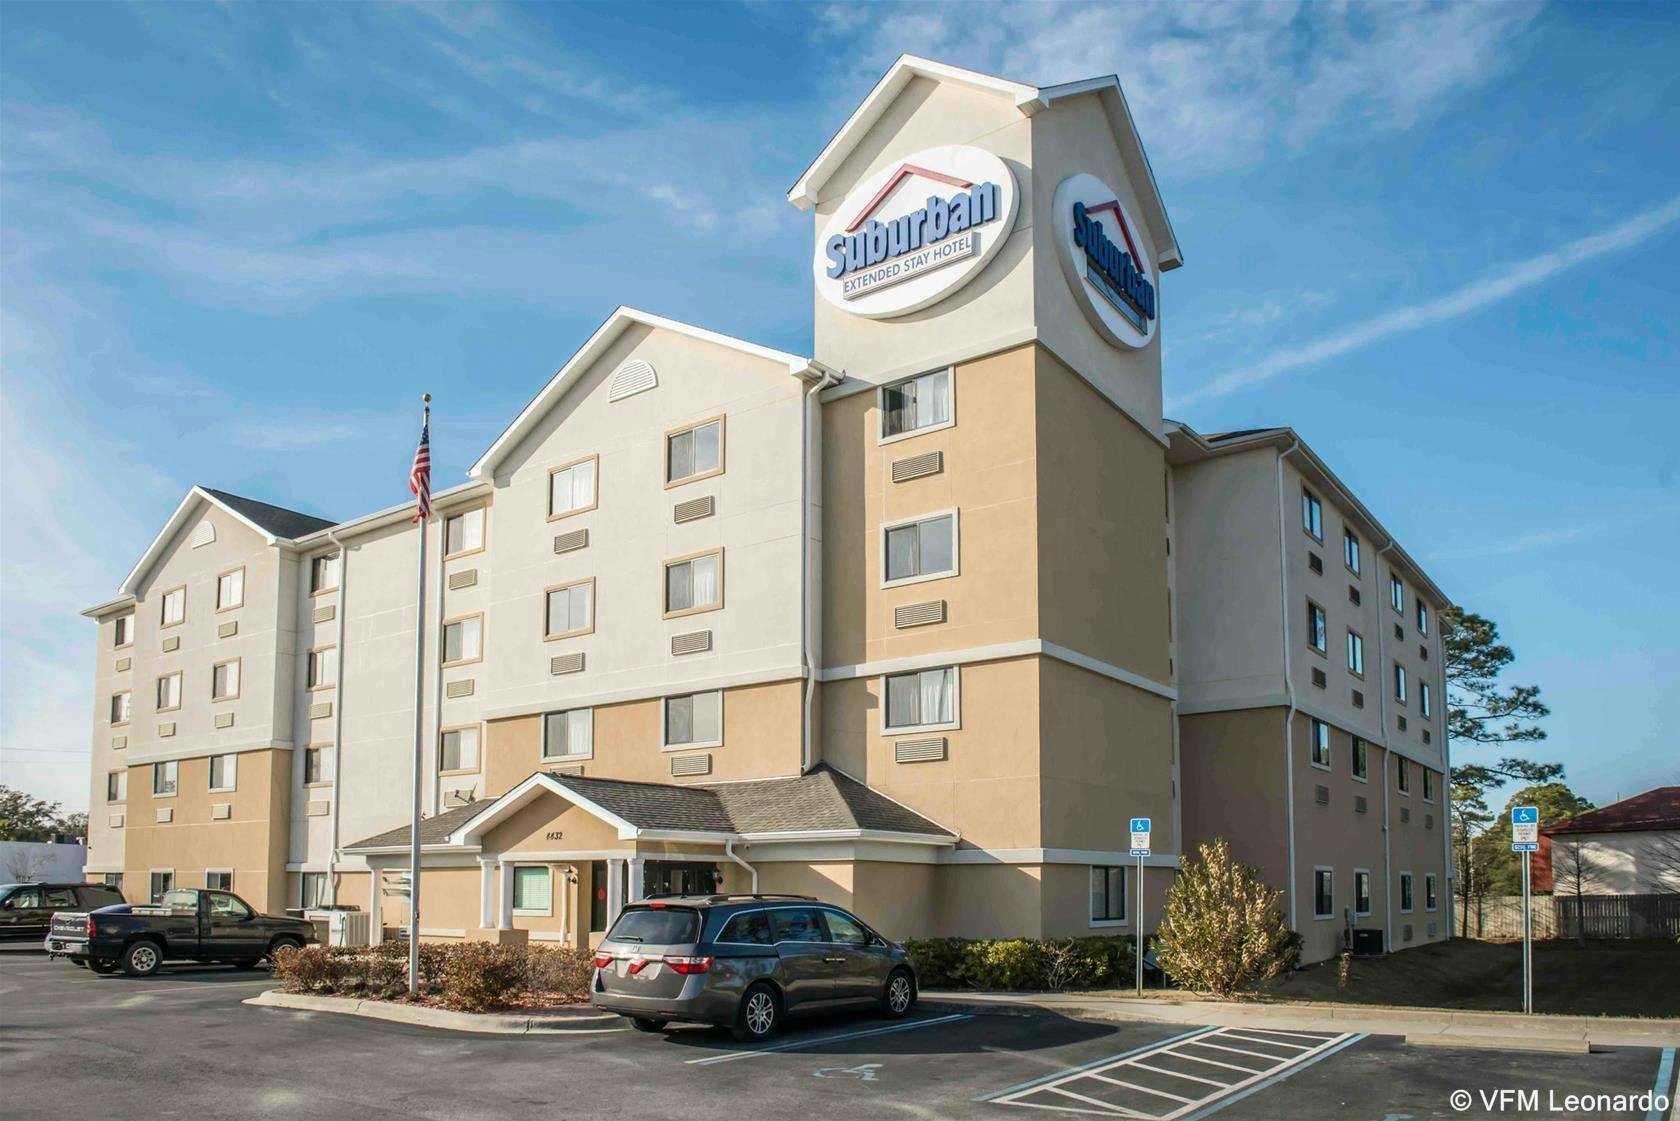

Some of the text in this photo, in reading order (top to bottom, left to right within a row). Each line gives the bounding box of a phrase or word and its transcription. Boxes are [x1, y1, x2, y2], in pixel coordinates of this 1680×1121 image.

[826, 181, 996, 279] Suburban
[844, 237, 971, 293] EXTENDED STAY HOTEL
